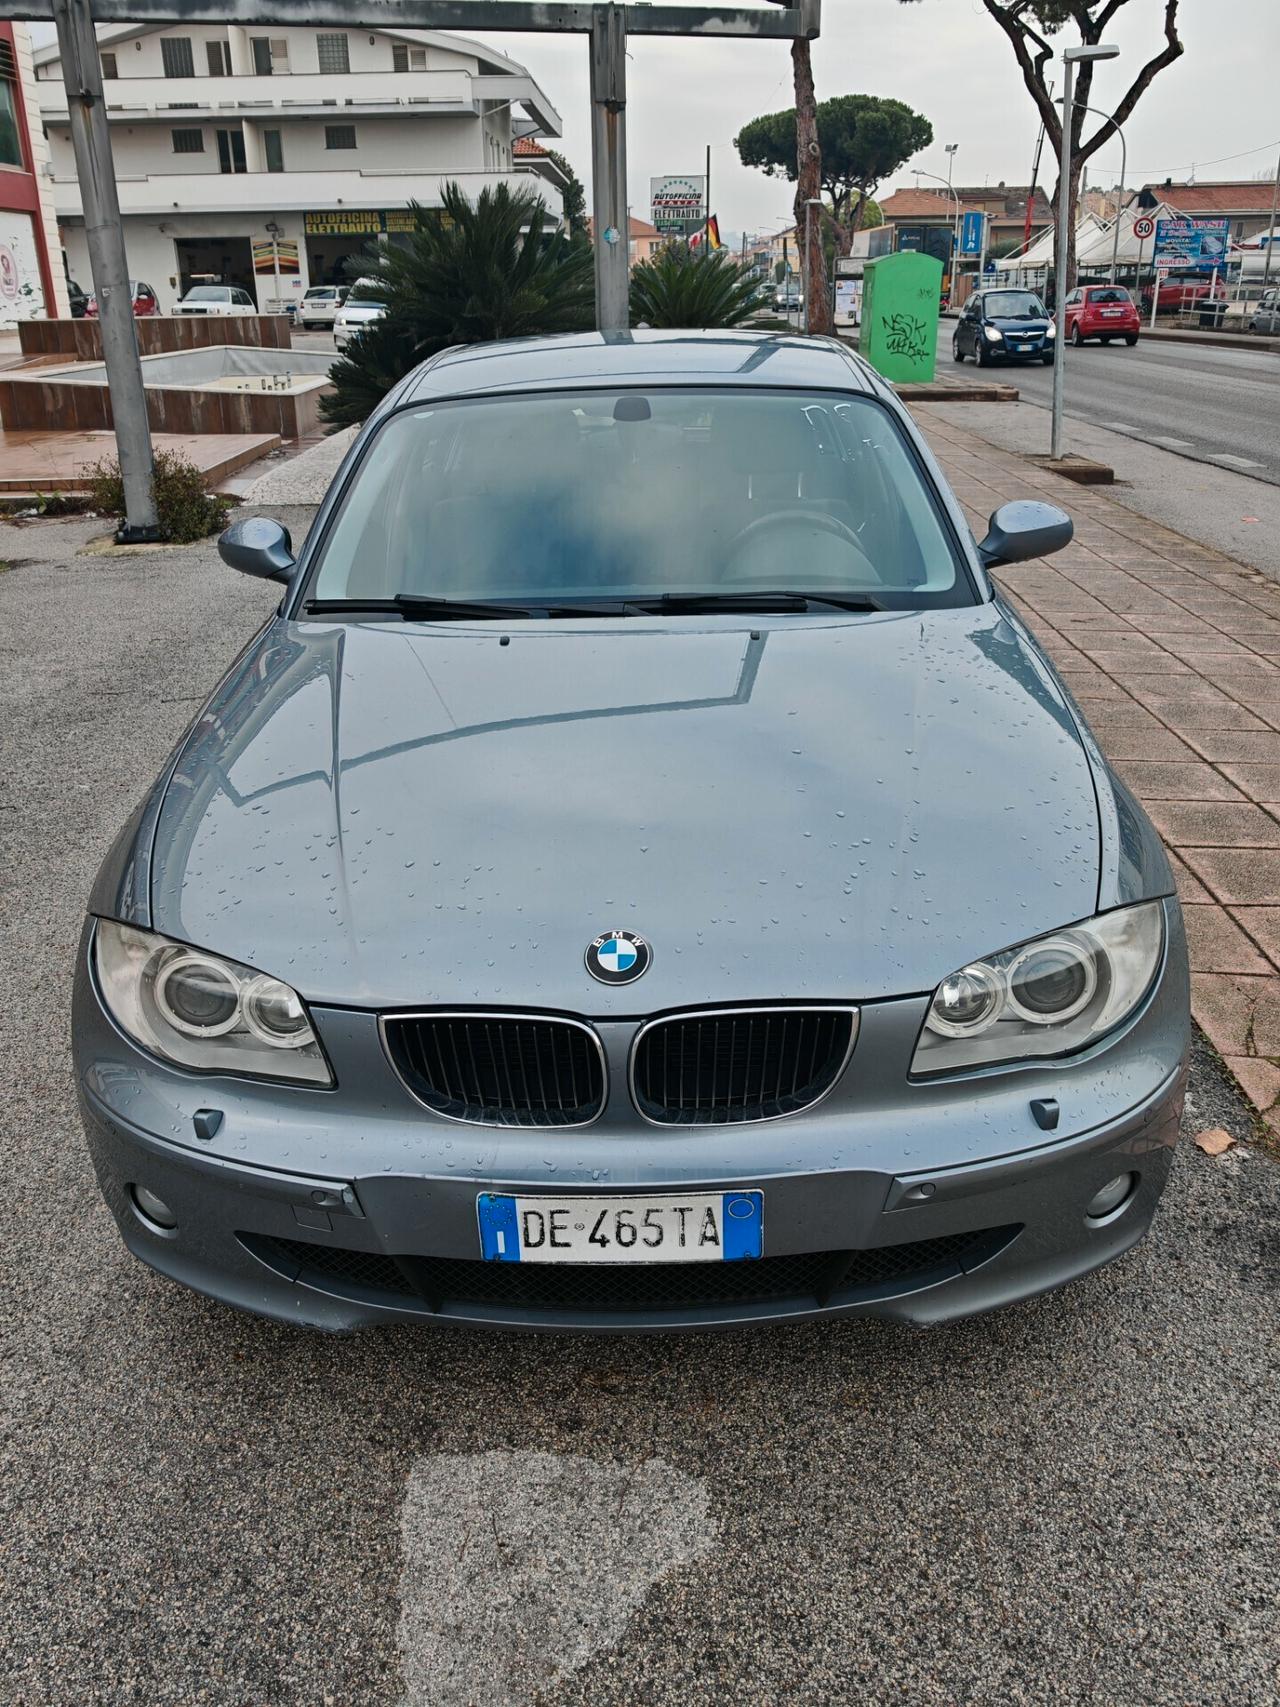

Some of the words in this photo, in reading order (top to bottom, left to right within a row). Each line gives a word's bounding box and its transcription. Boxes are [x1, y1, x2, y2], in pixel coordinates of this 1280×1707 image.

[305, 212, 380, 223] AUTOFFICINA
[654, 209, 700, 218] ELETTRAUTO
[305, 223, 381, 233] ELETTRAUTO
[1138, 222, 1150, 233] 50
[1161, 220, 1188, 230] CAR
[1191, 219, 1226, 229] WASH
[1157, 258, 1191, 266] INGRESSO
[592, 931, 644, 948] BMW
[522, 1209, 572, 1248] DE
[588, 1206, 721, 1248] 465TA
